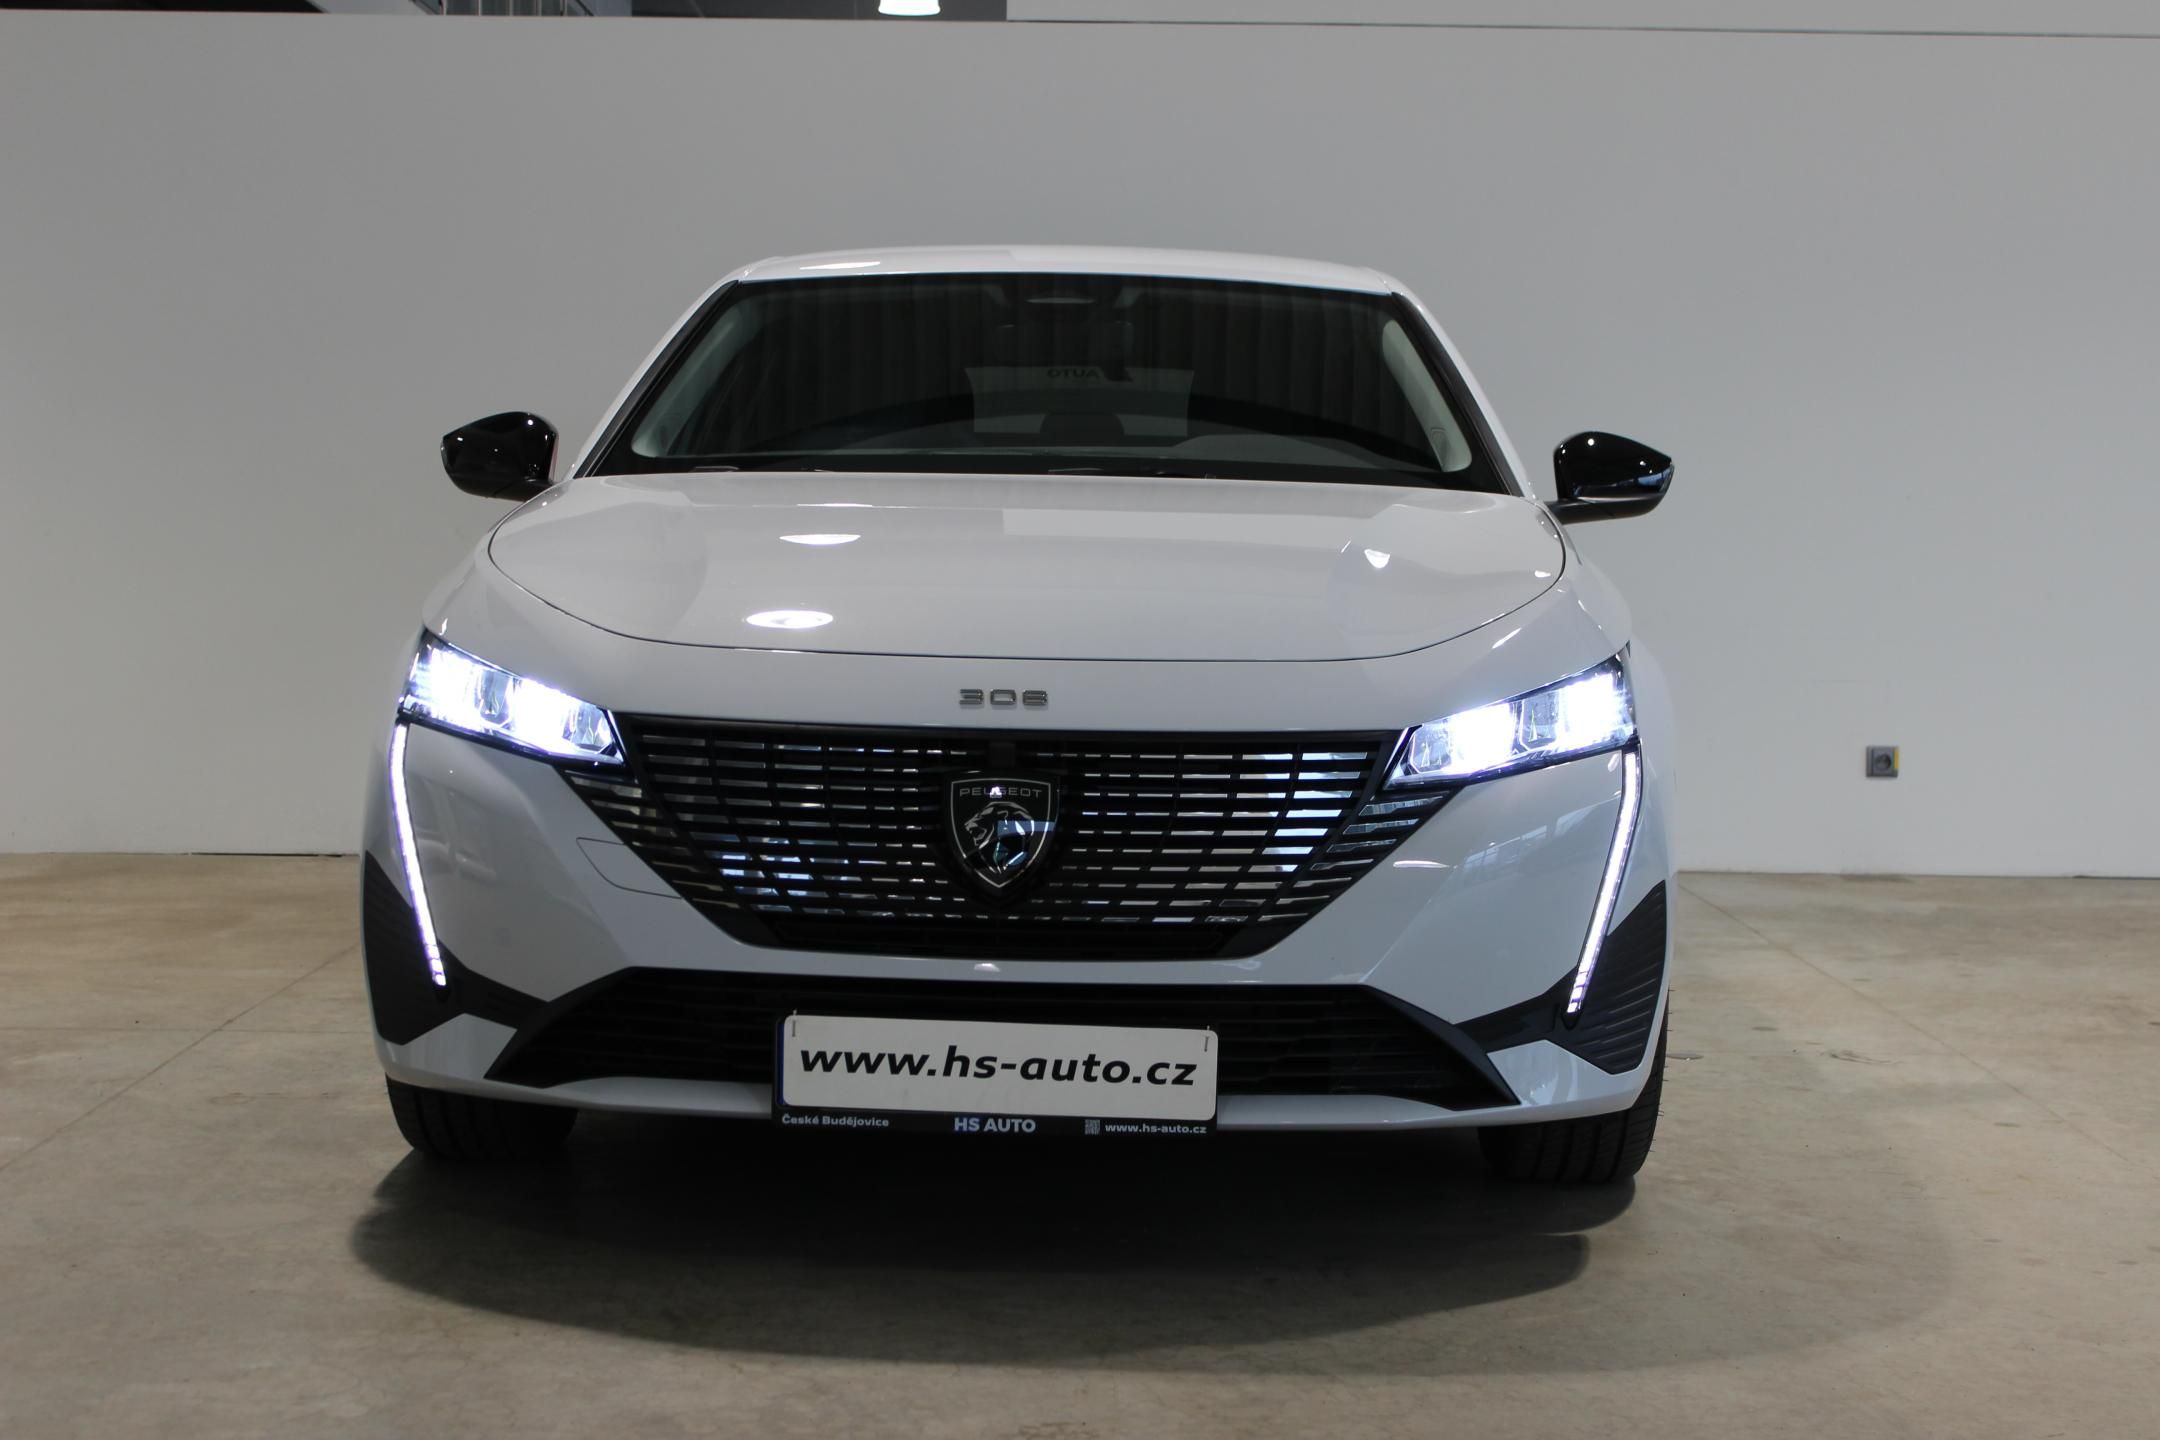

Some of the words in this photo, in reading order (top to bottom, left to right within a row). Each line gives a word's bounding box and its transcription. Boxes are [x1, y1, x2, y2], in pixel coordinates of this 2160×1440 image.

[959, 688, 1048, 707] 308
[959, 786, 1042, 799] PEUGEOT
[799, 1045, 1198, 1086] www.hs-auto.cz
[781, 1113, 820, 1126] České
[821, 1115, 890, 1128] Budějovice
[953, 1117, 981, 1132] HS
[983, 1118, 1036, 1134] AUTO
[1104, 1122, 1208, 1135] www.hs-auto.cz
